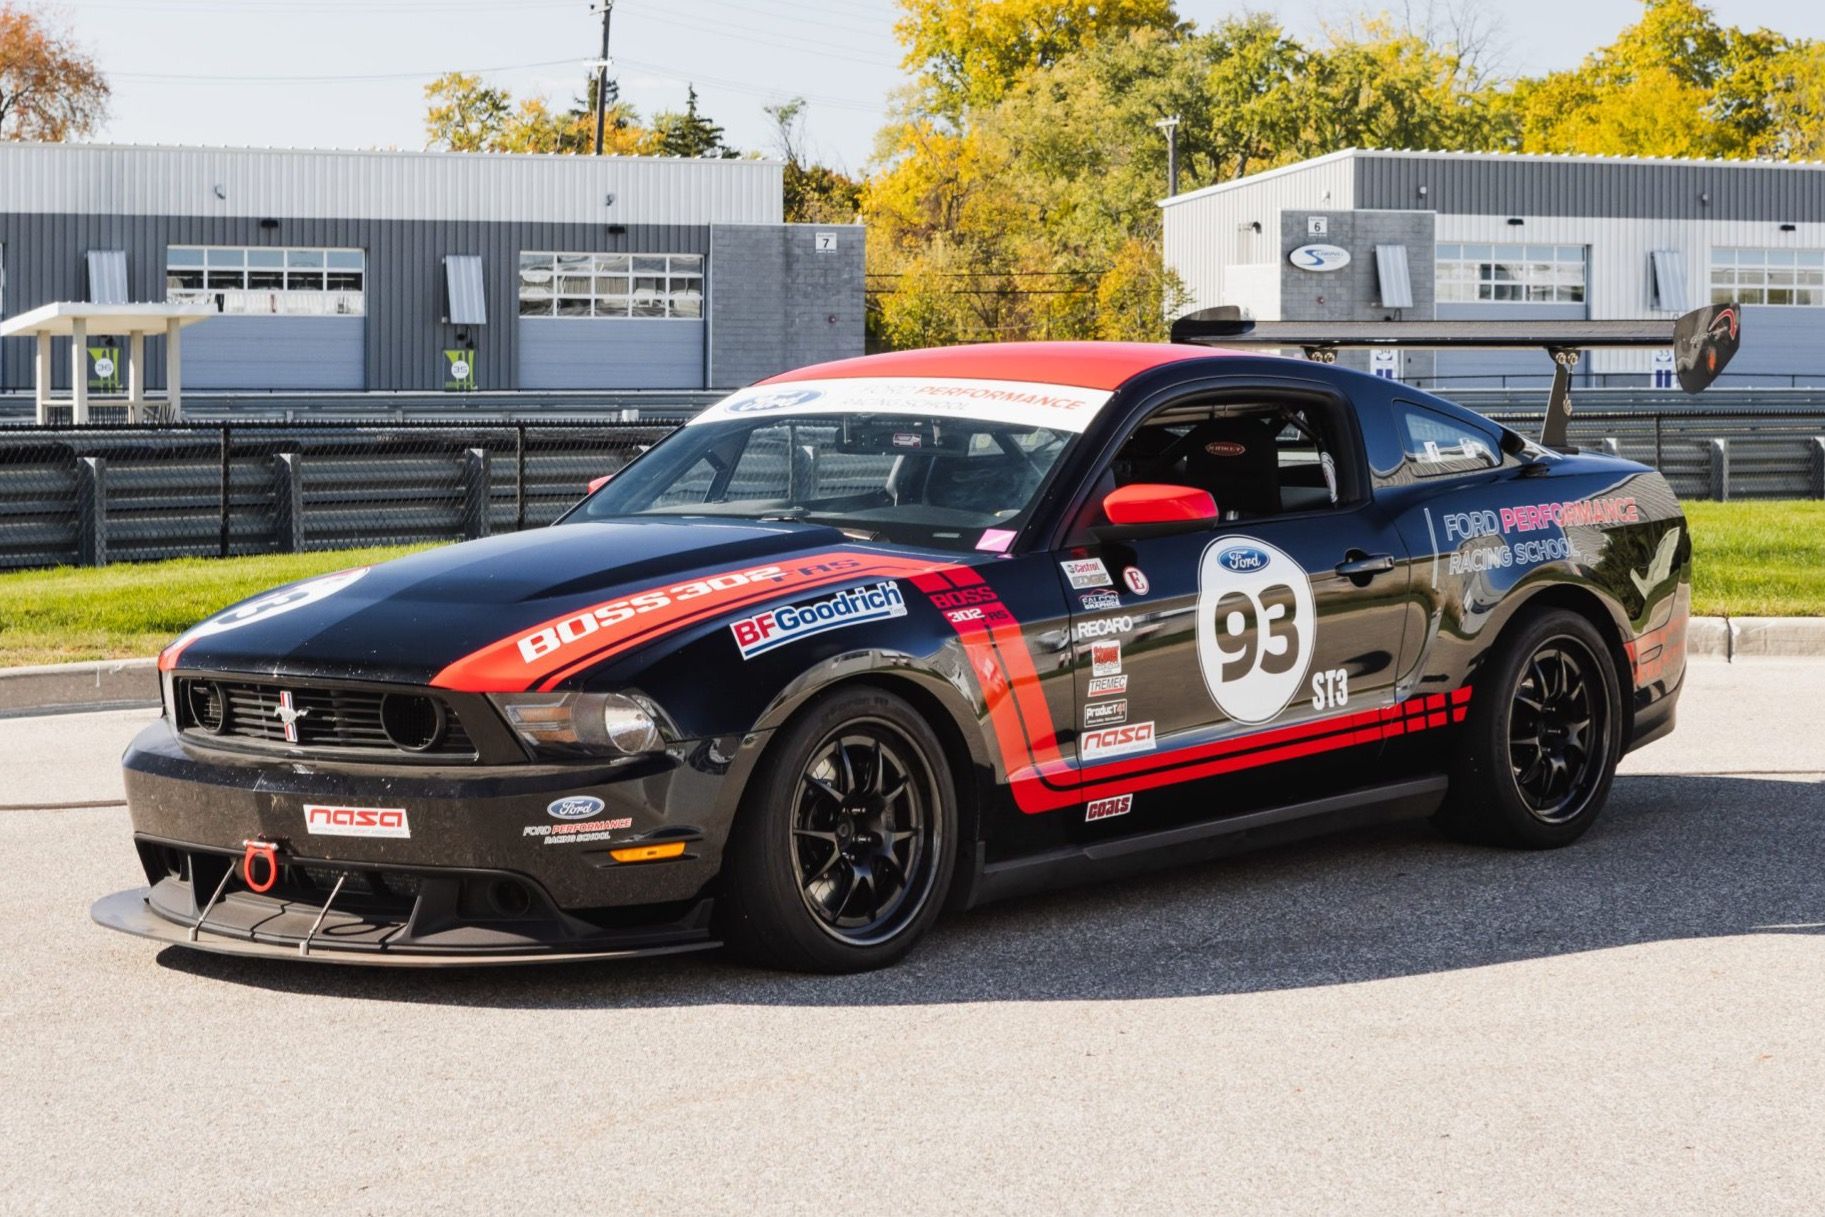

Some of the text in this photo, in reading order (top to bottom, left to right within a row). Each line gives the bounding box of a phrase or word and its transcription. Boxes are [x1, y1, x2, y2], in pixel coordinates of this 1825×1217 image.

[1314, 222, 1321, 232] 6
[822, 238, 830, 248] 7
[914, 385, 1086, 411] PERFORMANCE
[1443, 497, 1640, 541] FORD PERFORMANCE
[1228, 550, 1261, 569] Ford
[1449, 536, 1582, 575] RACING SCHOOL
[1074, 562, 1100, 573] Castrol
[1127, 570, 1145, 589] E
[929, 586, 998, 609] BOSS
[1081, 594, 1119, 604] FALCON
[1085, 601, 1121, 610] GRAPHICS
[516, 590, 672, 665] BOSS
[669, 566, 784, 602] 302
[733, 583, 901, 648] BFGoodrich
[947, 608, 985, 623] 302
[1078, 616, 1132, 638] RECARO
[1214, 583, 1300, 683] 93
[1090, 677, 1127, 691] TREMEC
[1312, 668, 1348, 710] ST3
[559, 799, 592, 815] Ford
[523, 817, 633, 837] FORD PERFORMANCE
[544, 831, 611, 845] RACING SCHOOL
